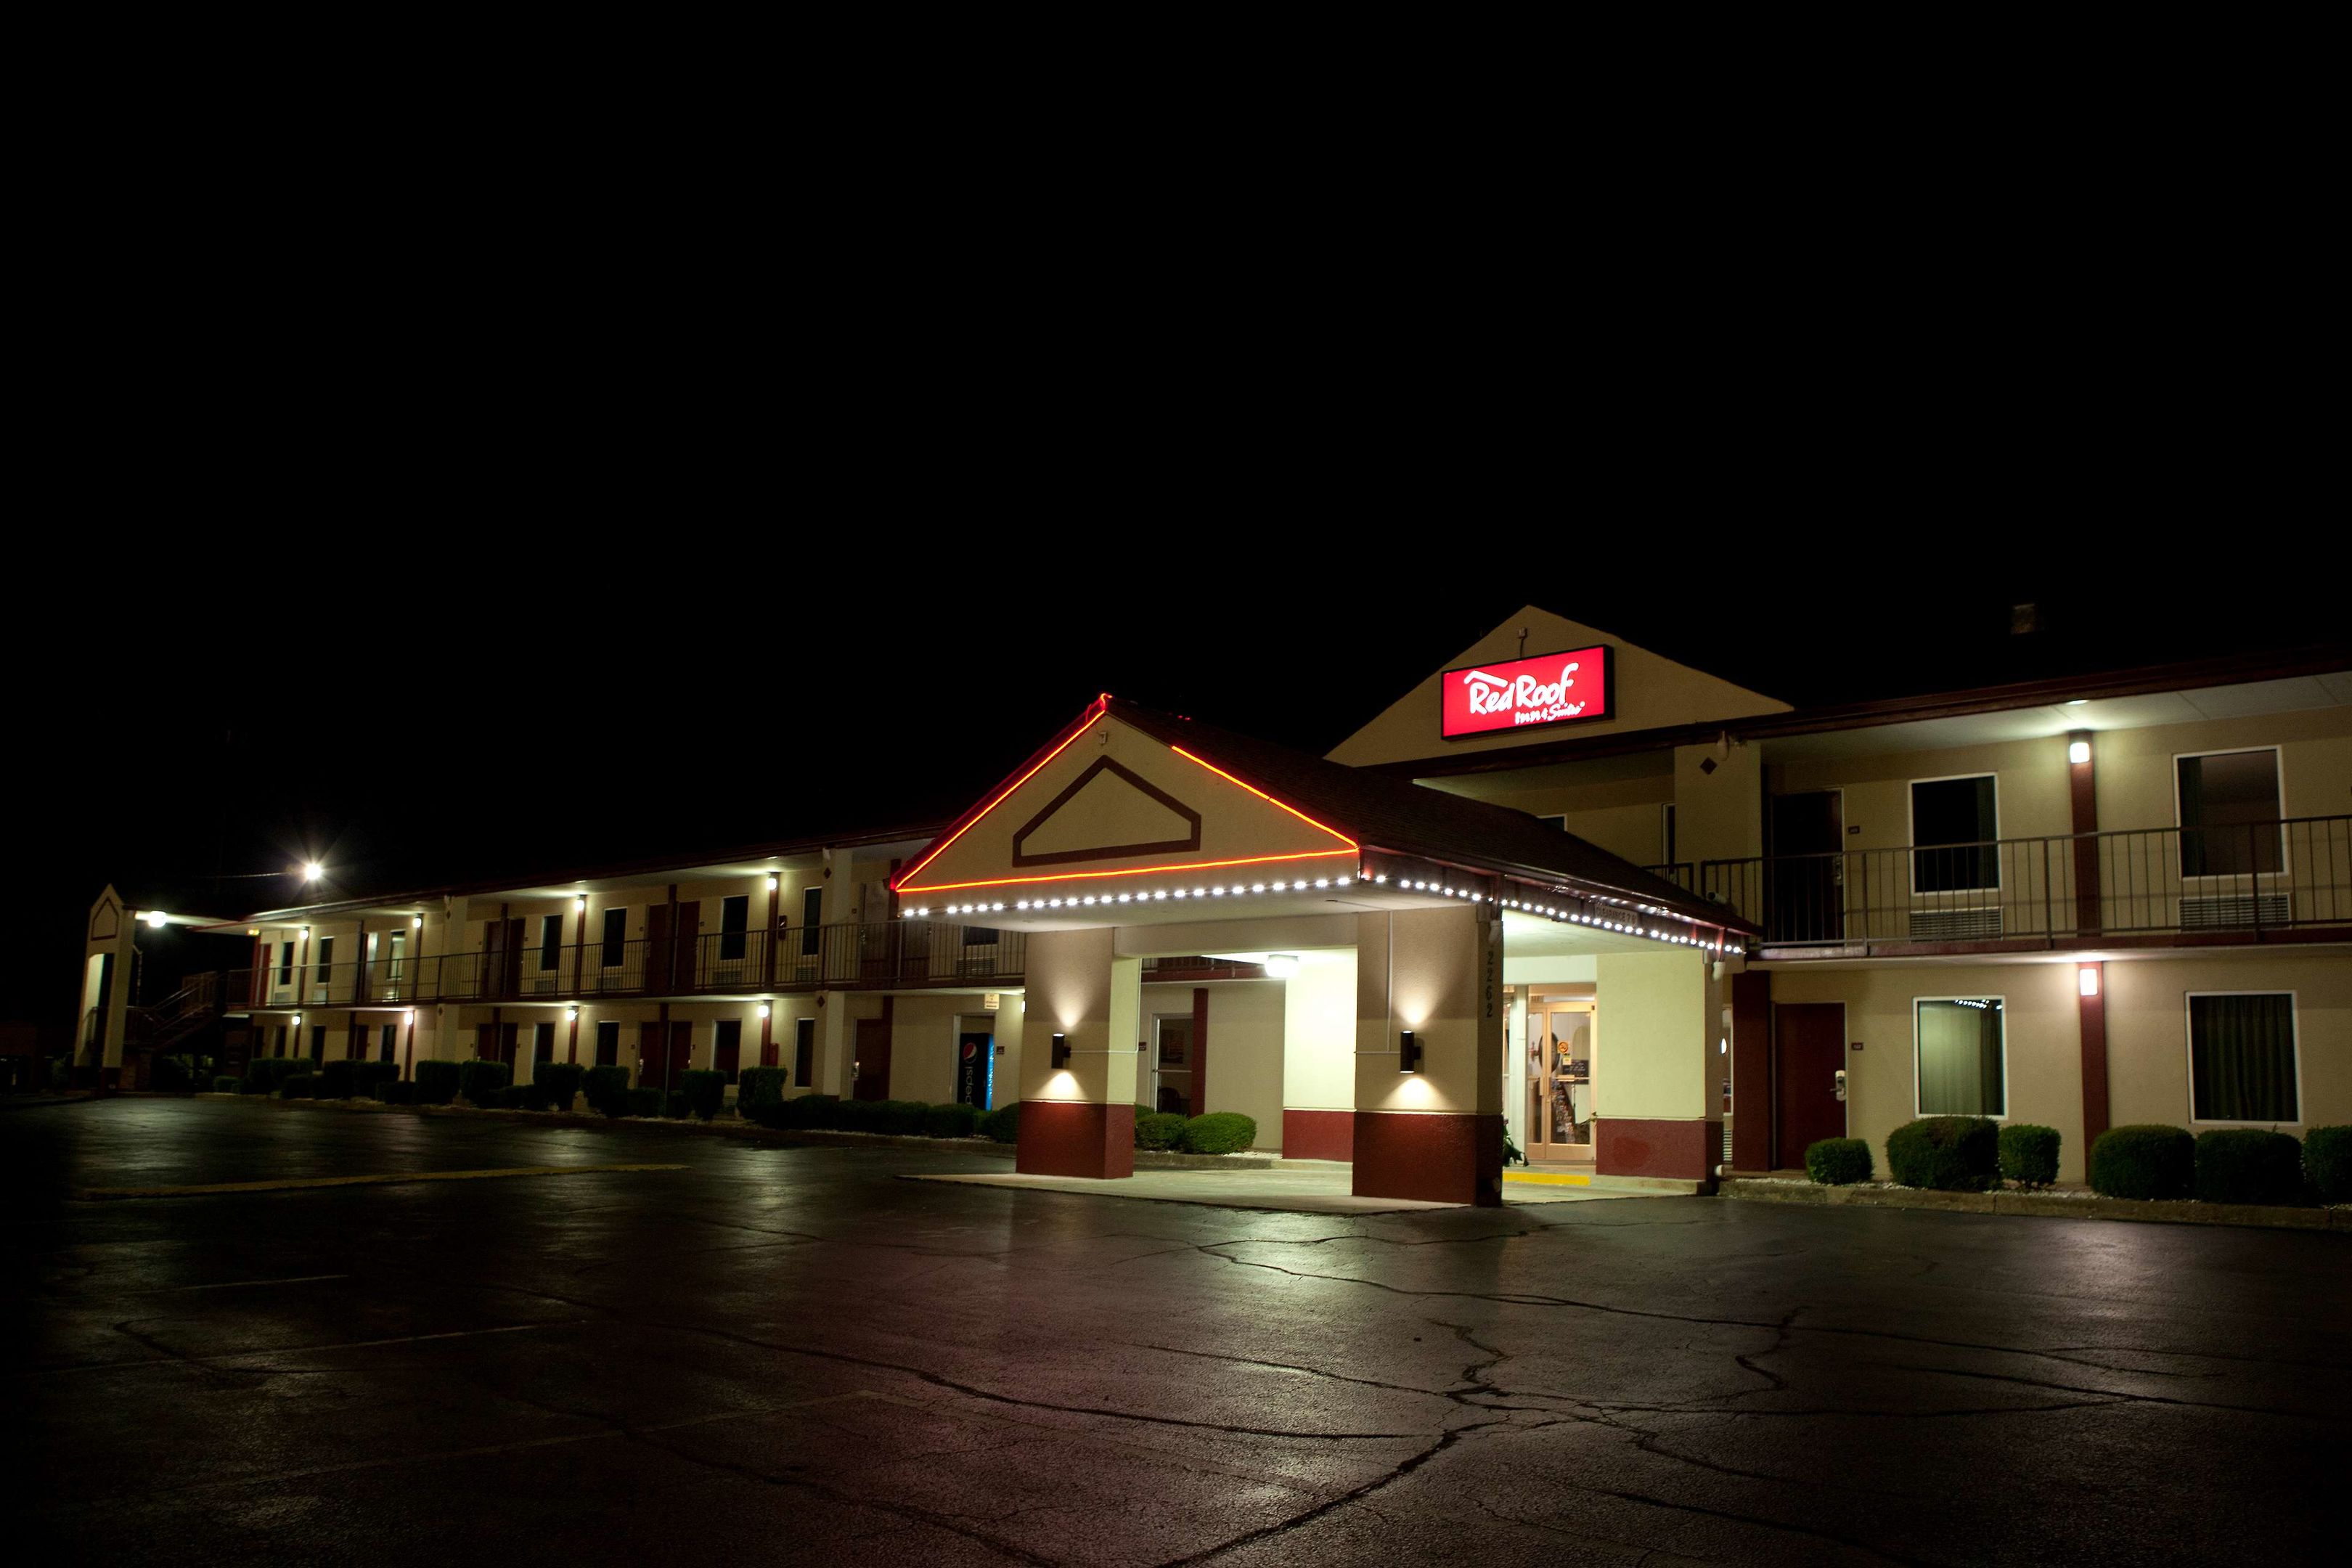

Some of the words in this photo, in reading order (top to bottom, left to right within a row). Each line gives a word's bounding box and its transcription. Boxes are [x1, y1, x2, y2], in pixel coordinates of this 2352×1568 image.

[1470, 681, 1516, 715] Red
[1516, 662, 1579, 709] Roof
[1485, 950, 1494, 1018] 2262
[965, 1066, 974, 1105] pepsi
